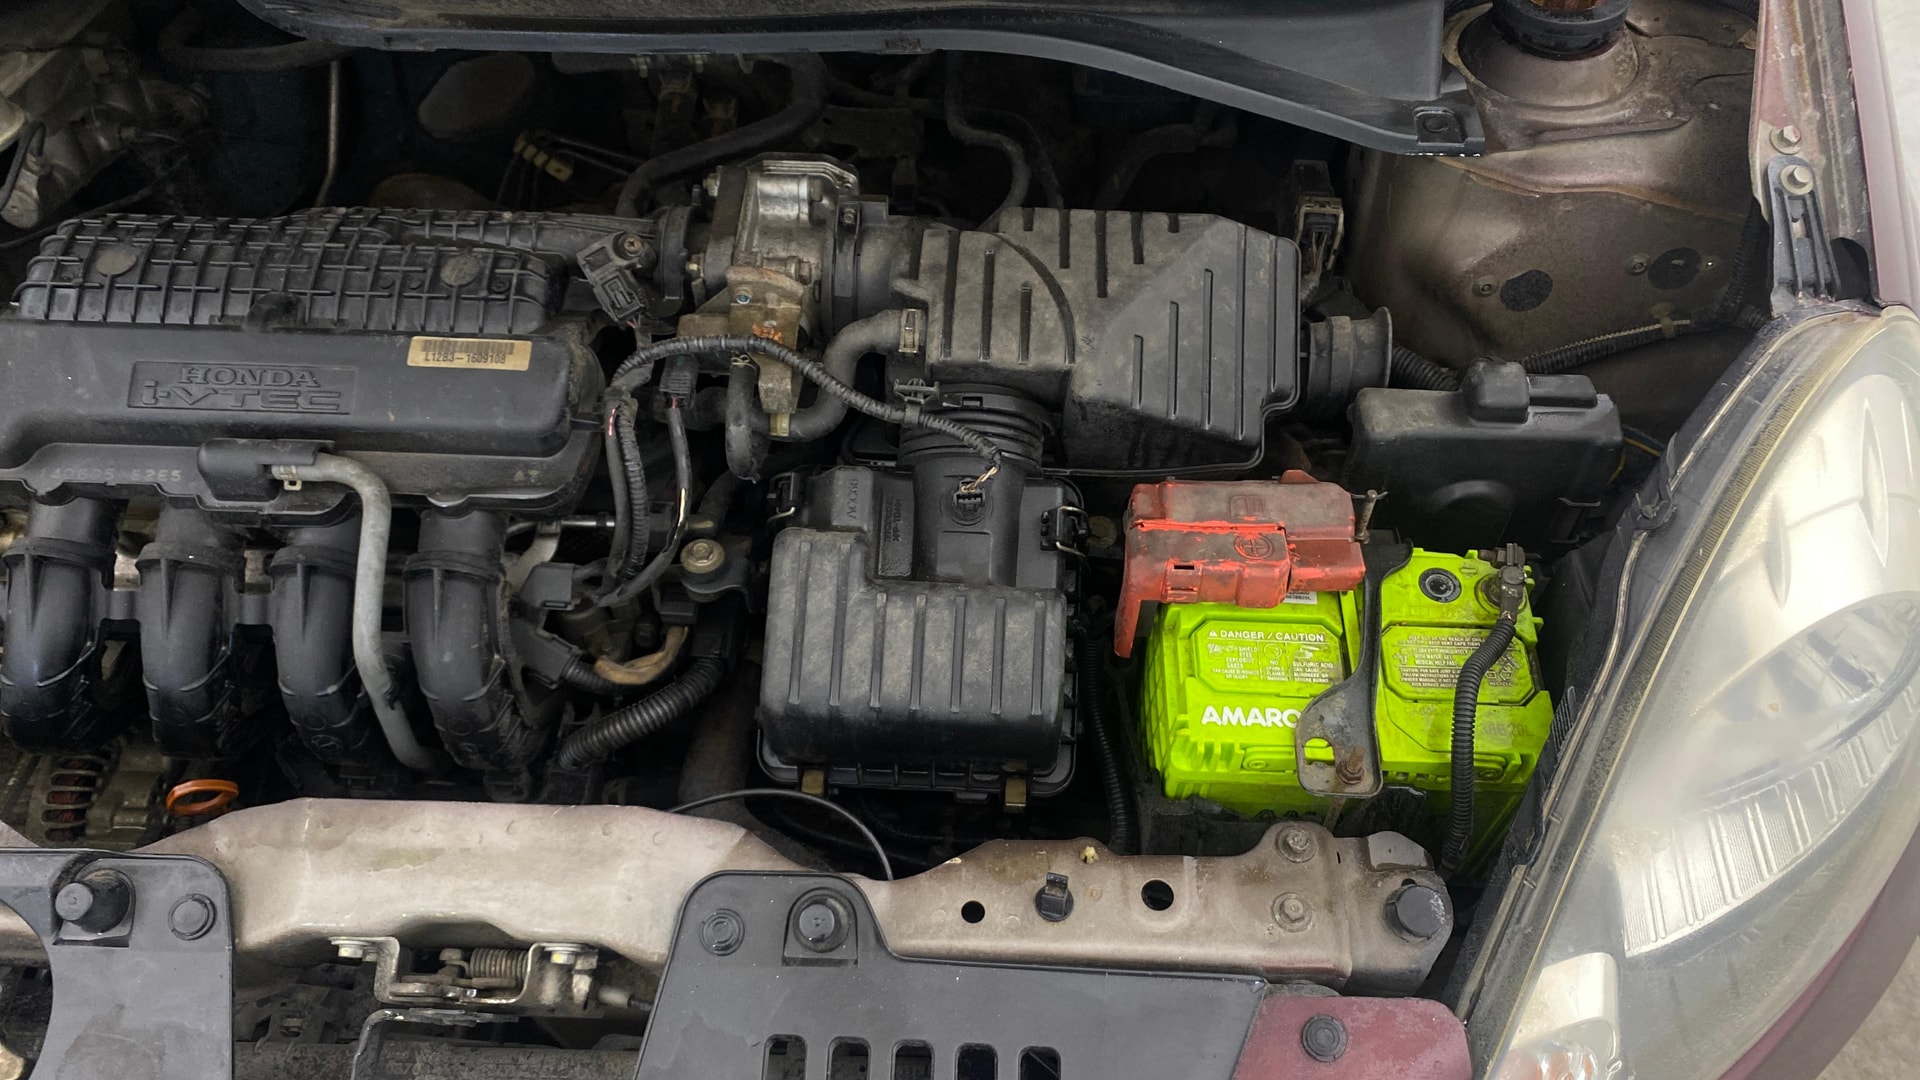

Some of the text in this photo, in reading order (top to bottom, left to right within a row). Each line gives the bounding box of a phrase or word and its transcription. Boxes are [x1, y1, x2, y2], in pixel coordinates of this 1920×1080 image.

[178, 366, 321, 388] HONDA
[142, 379, 341, 411] i-VTEC
[1220, 630, 1265, 640] DANGER
[1275, 632, 1325, 642] CAUTION
[1201, 705, 1302, 729] AMARO
